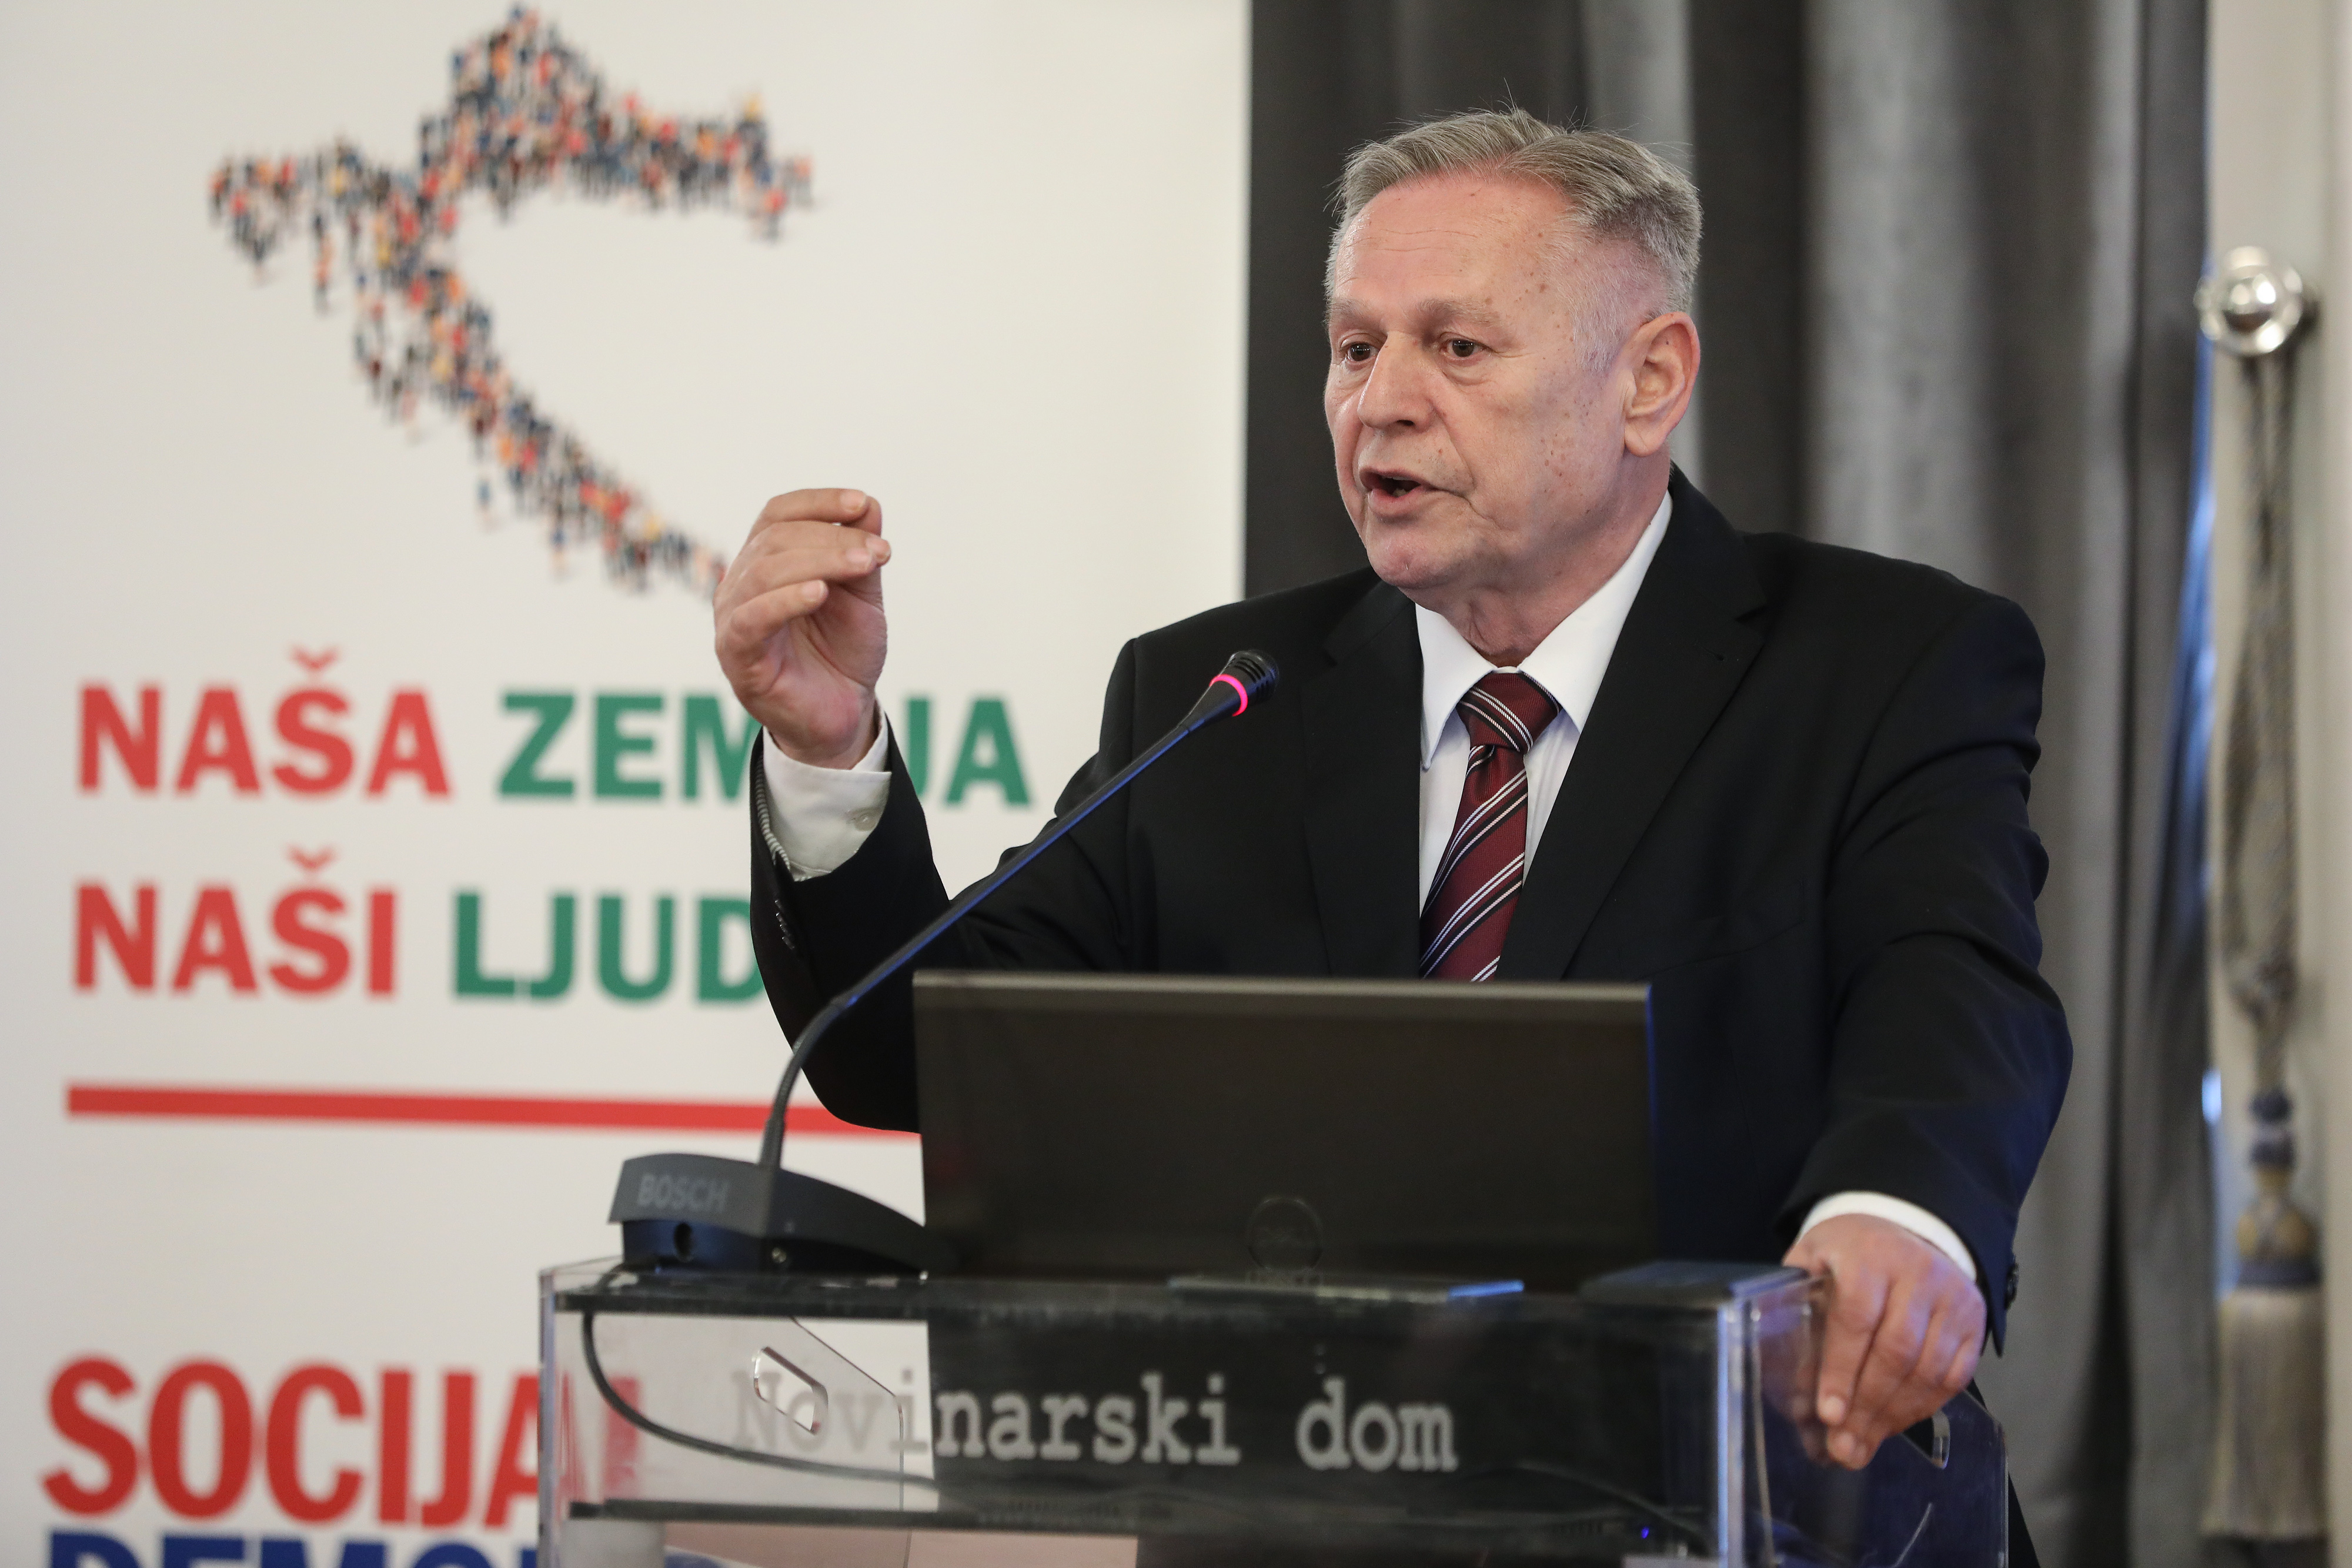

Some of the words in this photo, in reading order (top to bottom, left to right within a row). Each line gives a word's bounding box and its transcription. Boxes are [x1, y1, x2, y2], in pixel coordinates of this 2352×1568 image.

[77, 649, 452, 798] NAŠA
[498, 690, 1031, 807] ZEMJA
[74, 848, 397, 998] NAŠI
[453, 891, 766, 1003] LJUD
[637, 1174, 730, 1213] BOSCH
[729, 1367, 1240, 1465] Novinarski
[1295, 1377, 1458, 1472] dom
